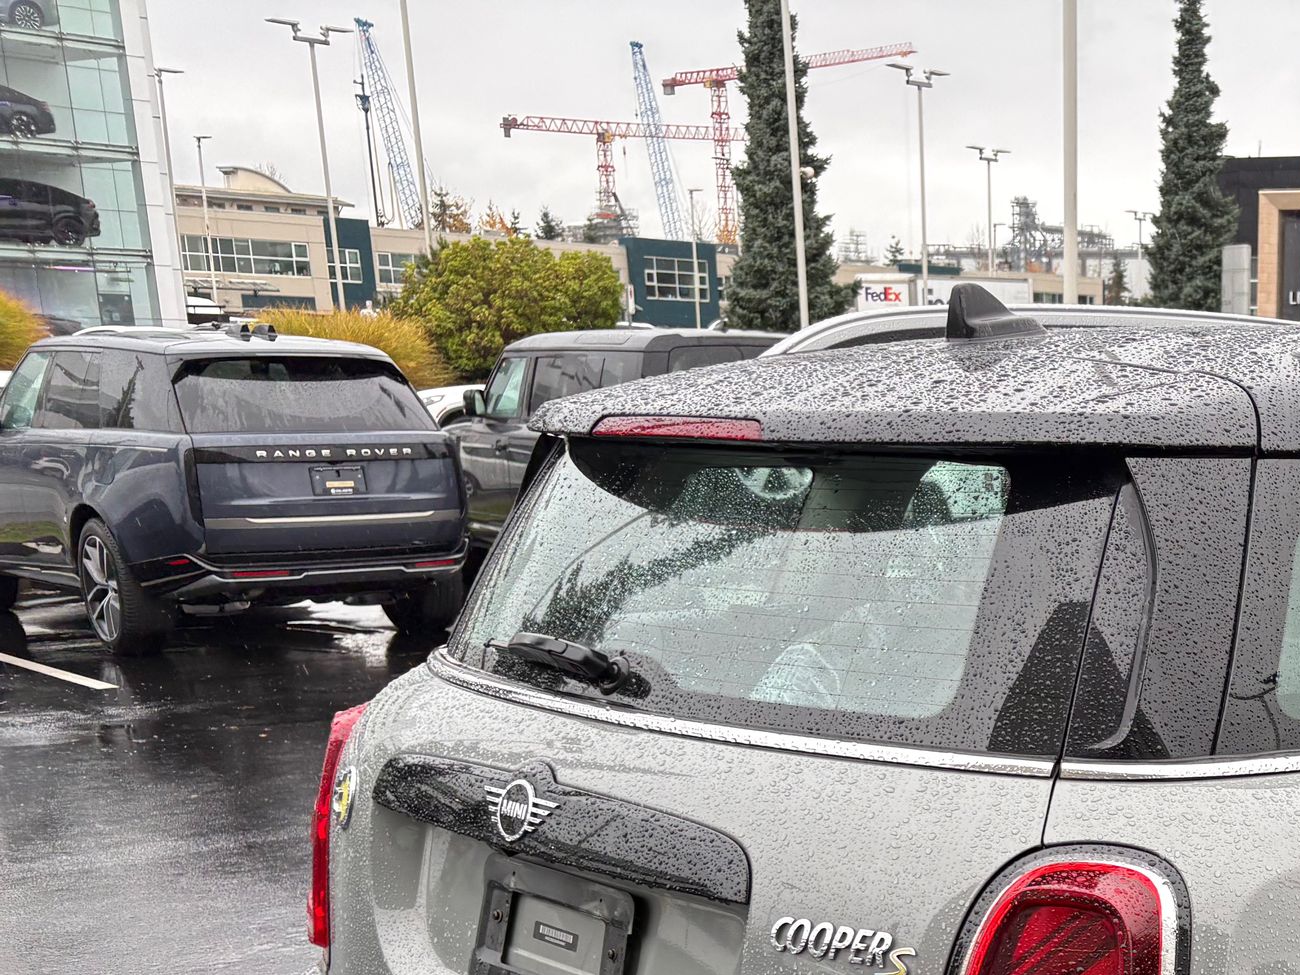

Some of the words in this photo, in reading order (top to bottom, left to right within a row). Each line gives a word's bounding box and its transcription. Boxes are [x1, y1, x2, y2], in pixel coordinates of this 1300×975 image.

[865, 287, 901, 302] FedEx
[255, 449, 332, 458] RANGE
[346, 447, 412, 456] ROVER
[501, 799, 528, 820] MINI
[770, 916, 893, 968] COOPER
